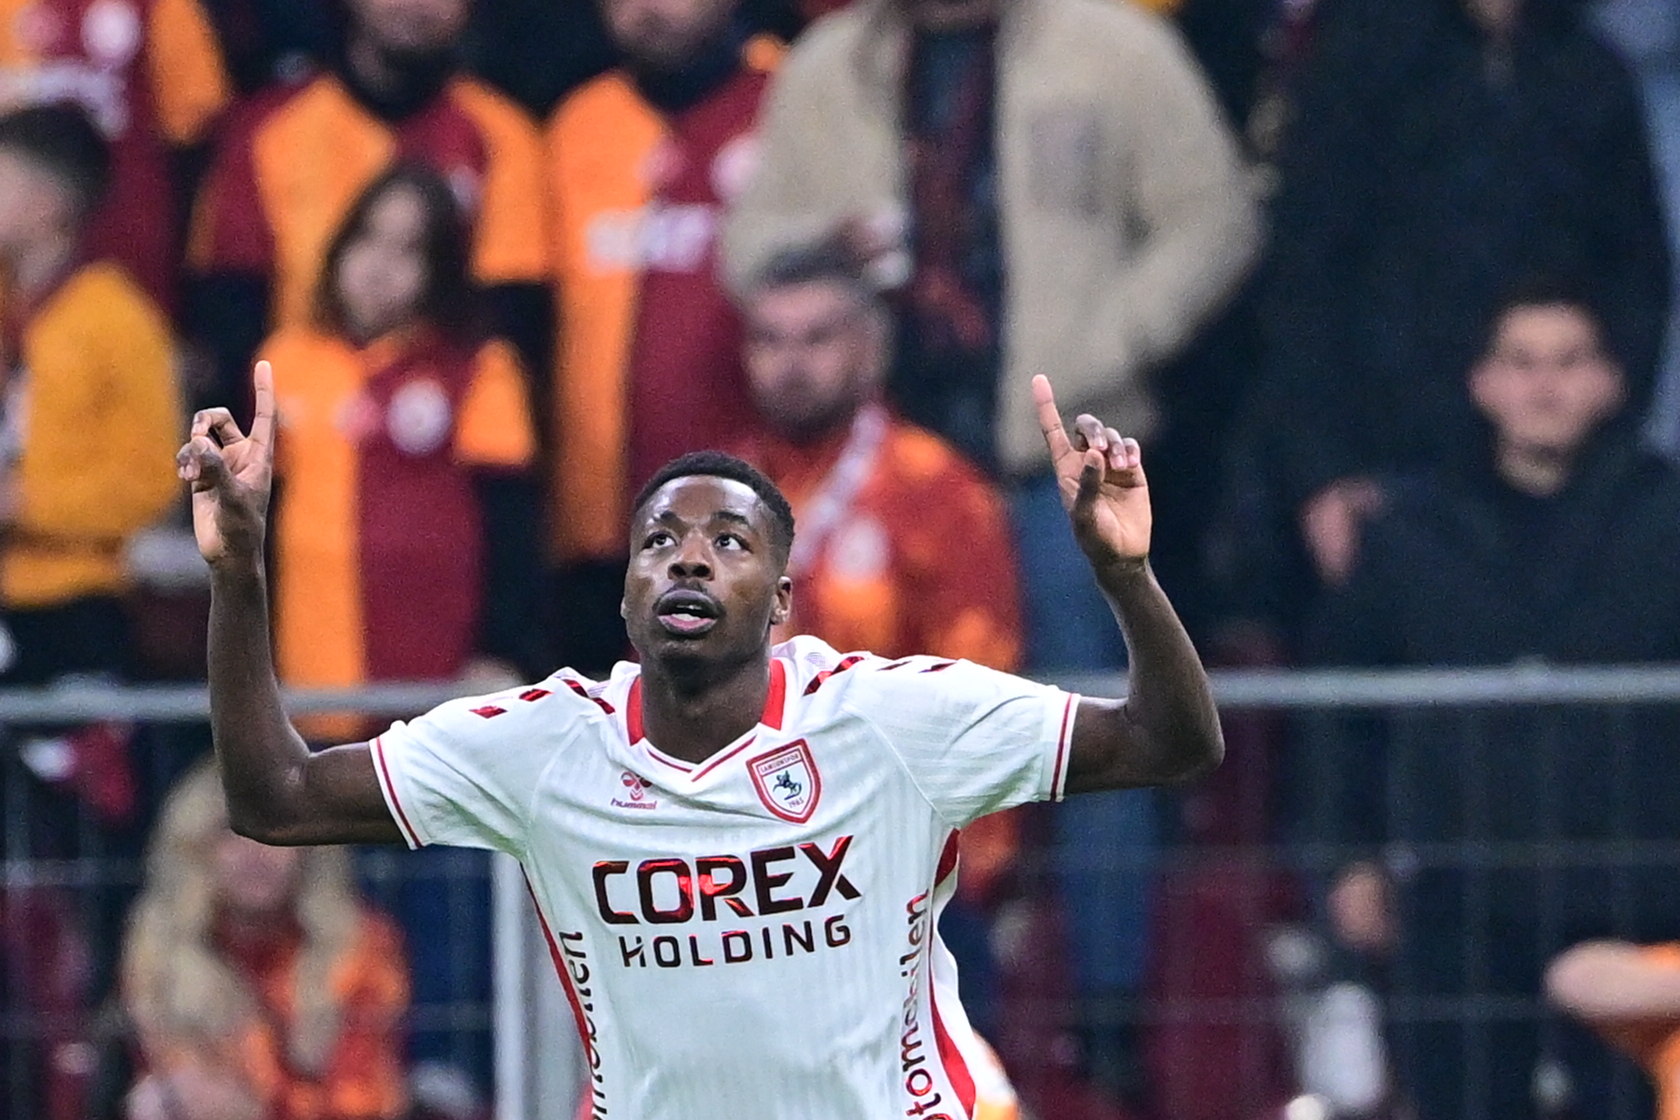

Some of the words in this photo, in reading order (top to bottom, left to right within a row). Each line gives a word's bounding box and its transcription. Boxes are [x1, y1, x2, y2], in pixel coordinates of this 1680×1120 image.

[610, 797, 658, 811] hummel
[592, 835, 862, 925] COREX
[618, 915, 852, 968] HOLDING
